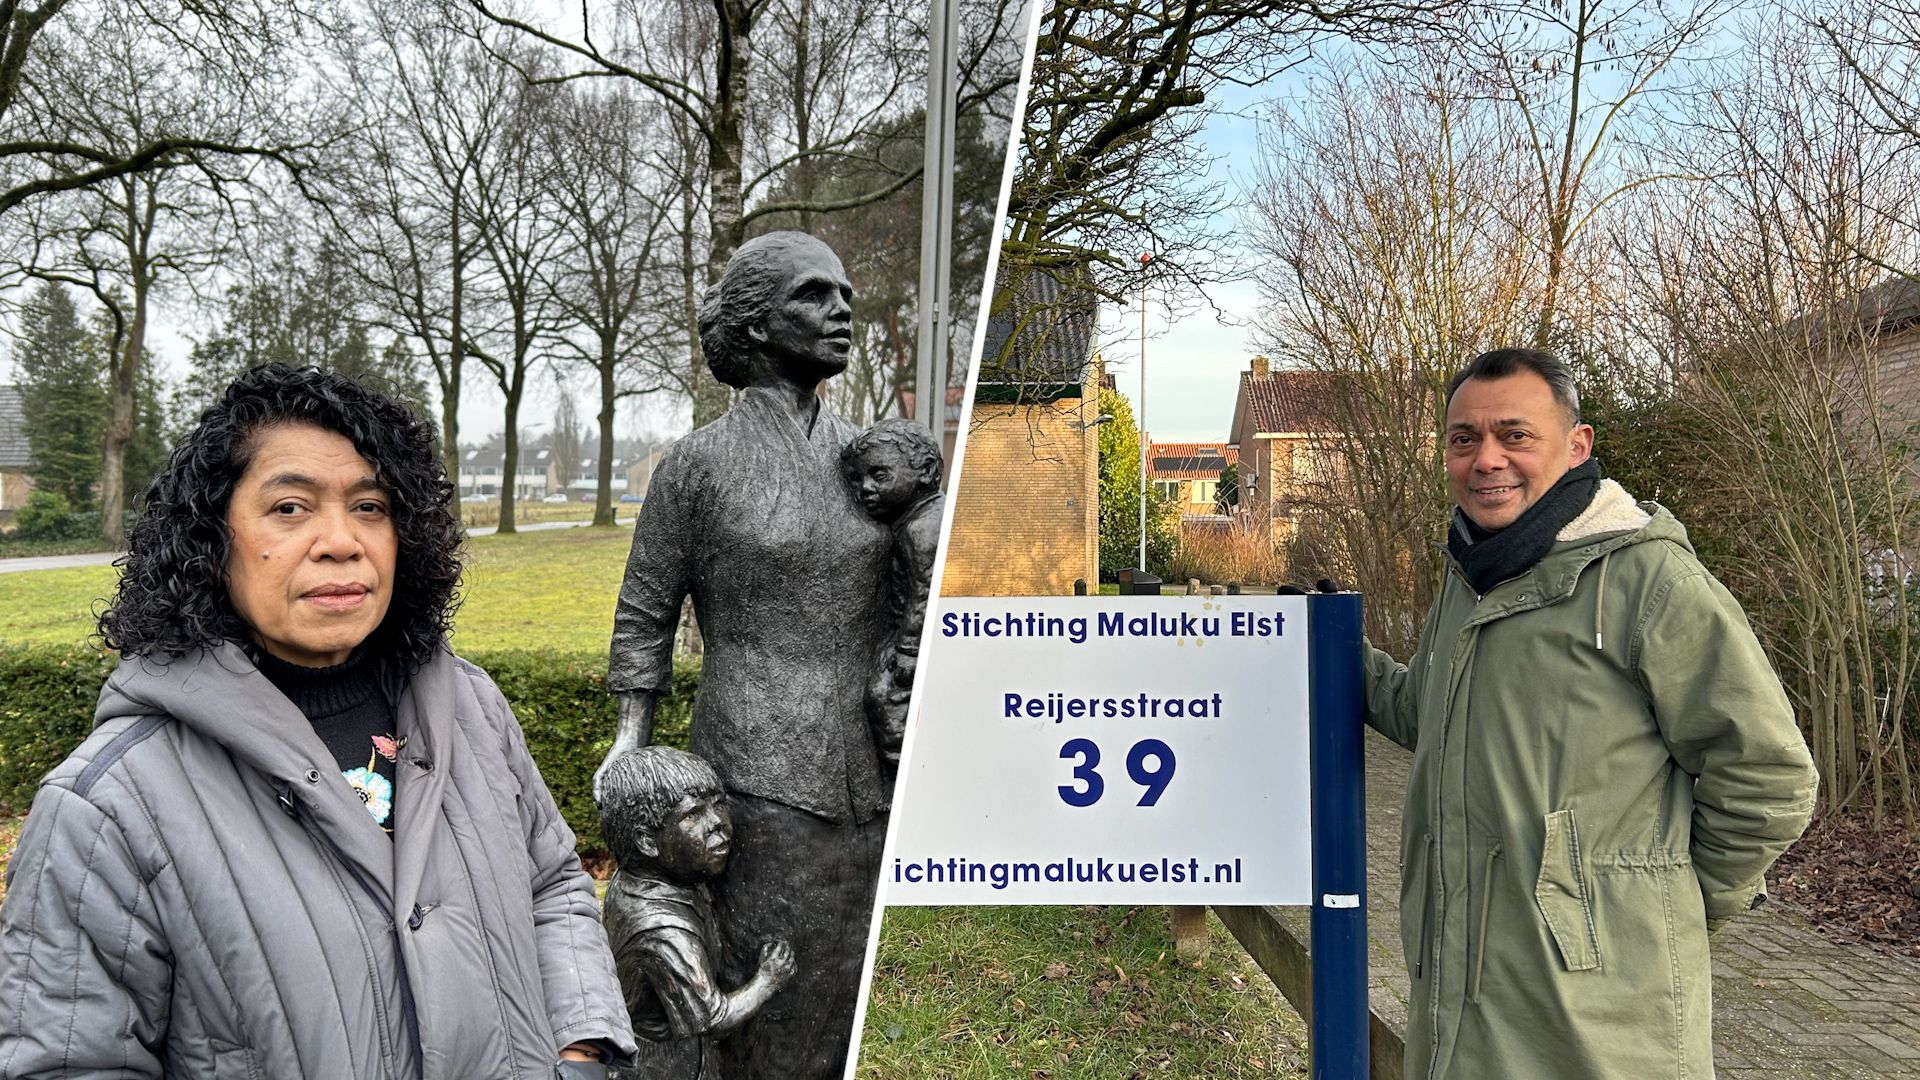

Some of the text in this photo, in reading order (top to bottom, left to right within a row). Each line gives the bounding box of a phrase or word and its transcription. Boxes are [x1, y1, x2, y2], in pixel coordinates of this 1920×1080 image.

[942, 612, 1285, 643] Stichting Maluku Elst
[1004, 693, 1222, 723] Reijersstraat
[889, 858, 1242, 889] ichtingmalukuelst.nl
